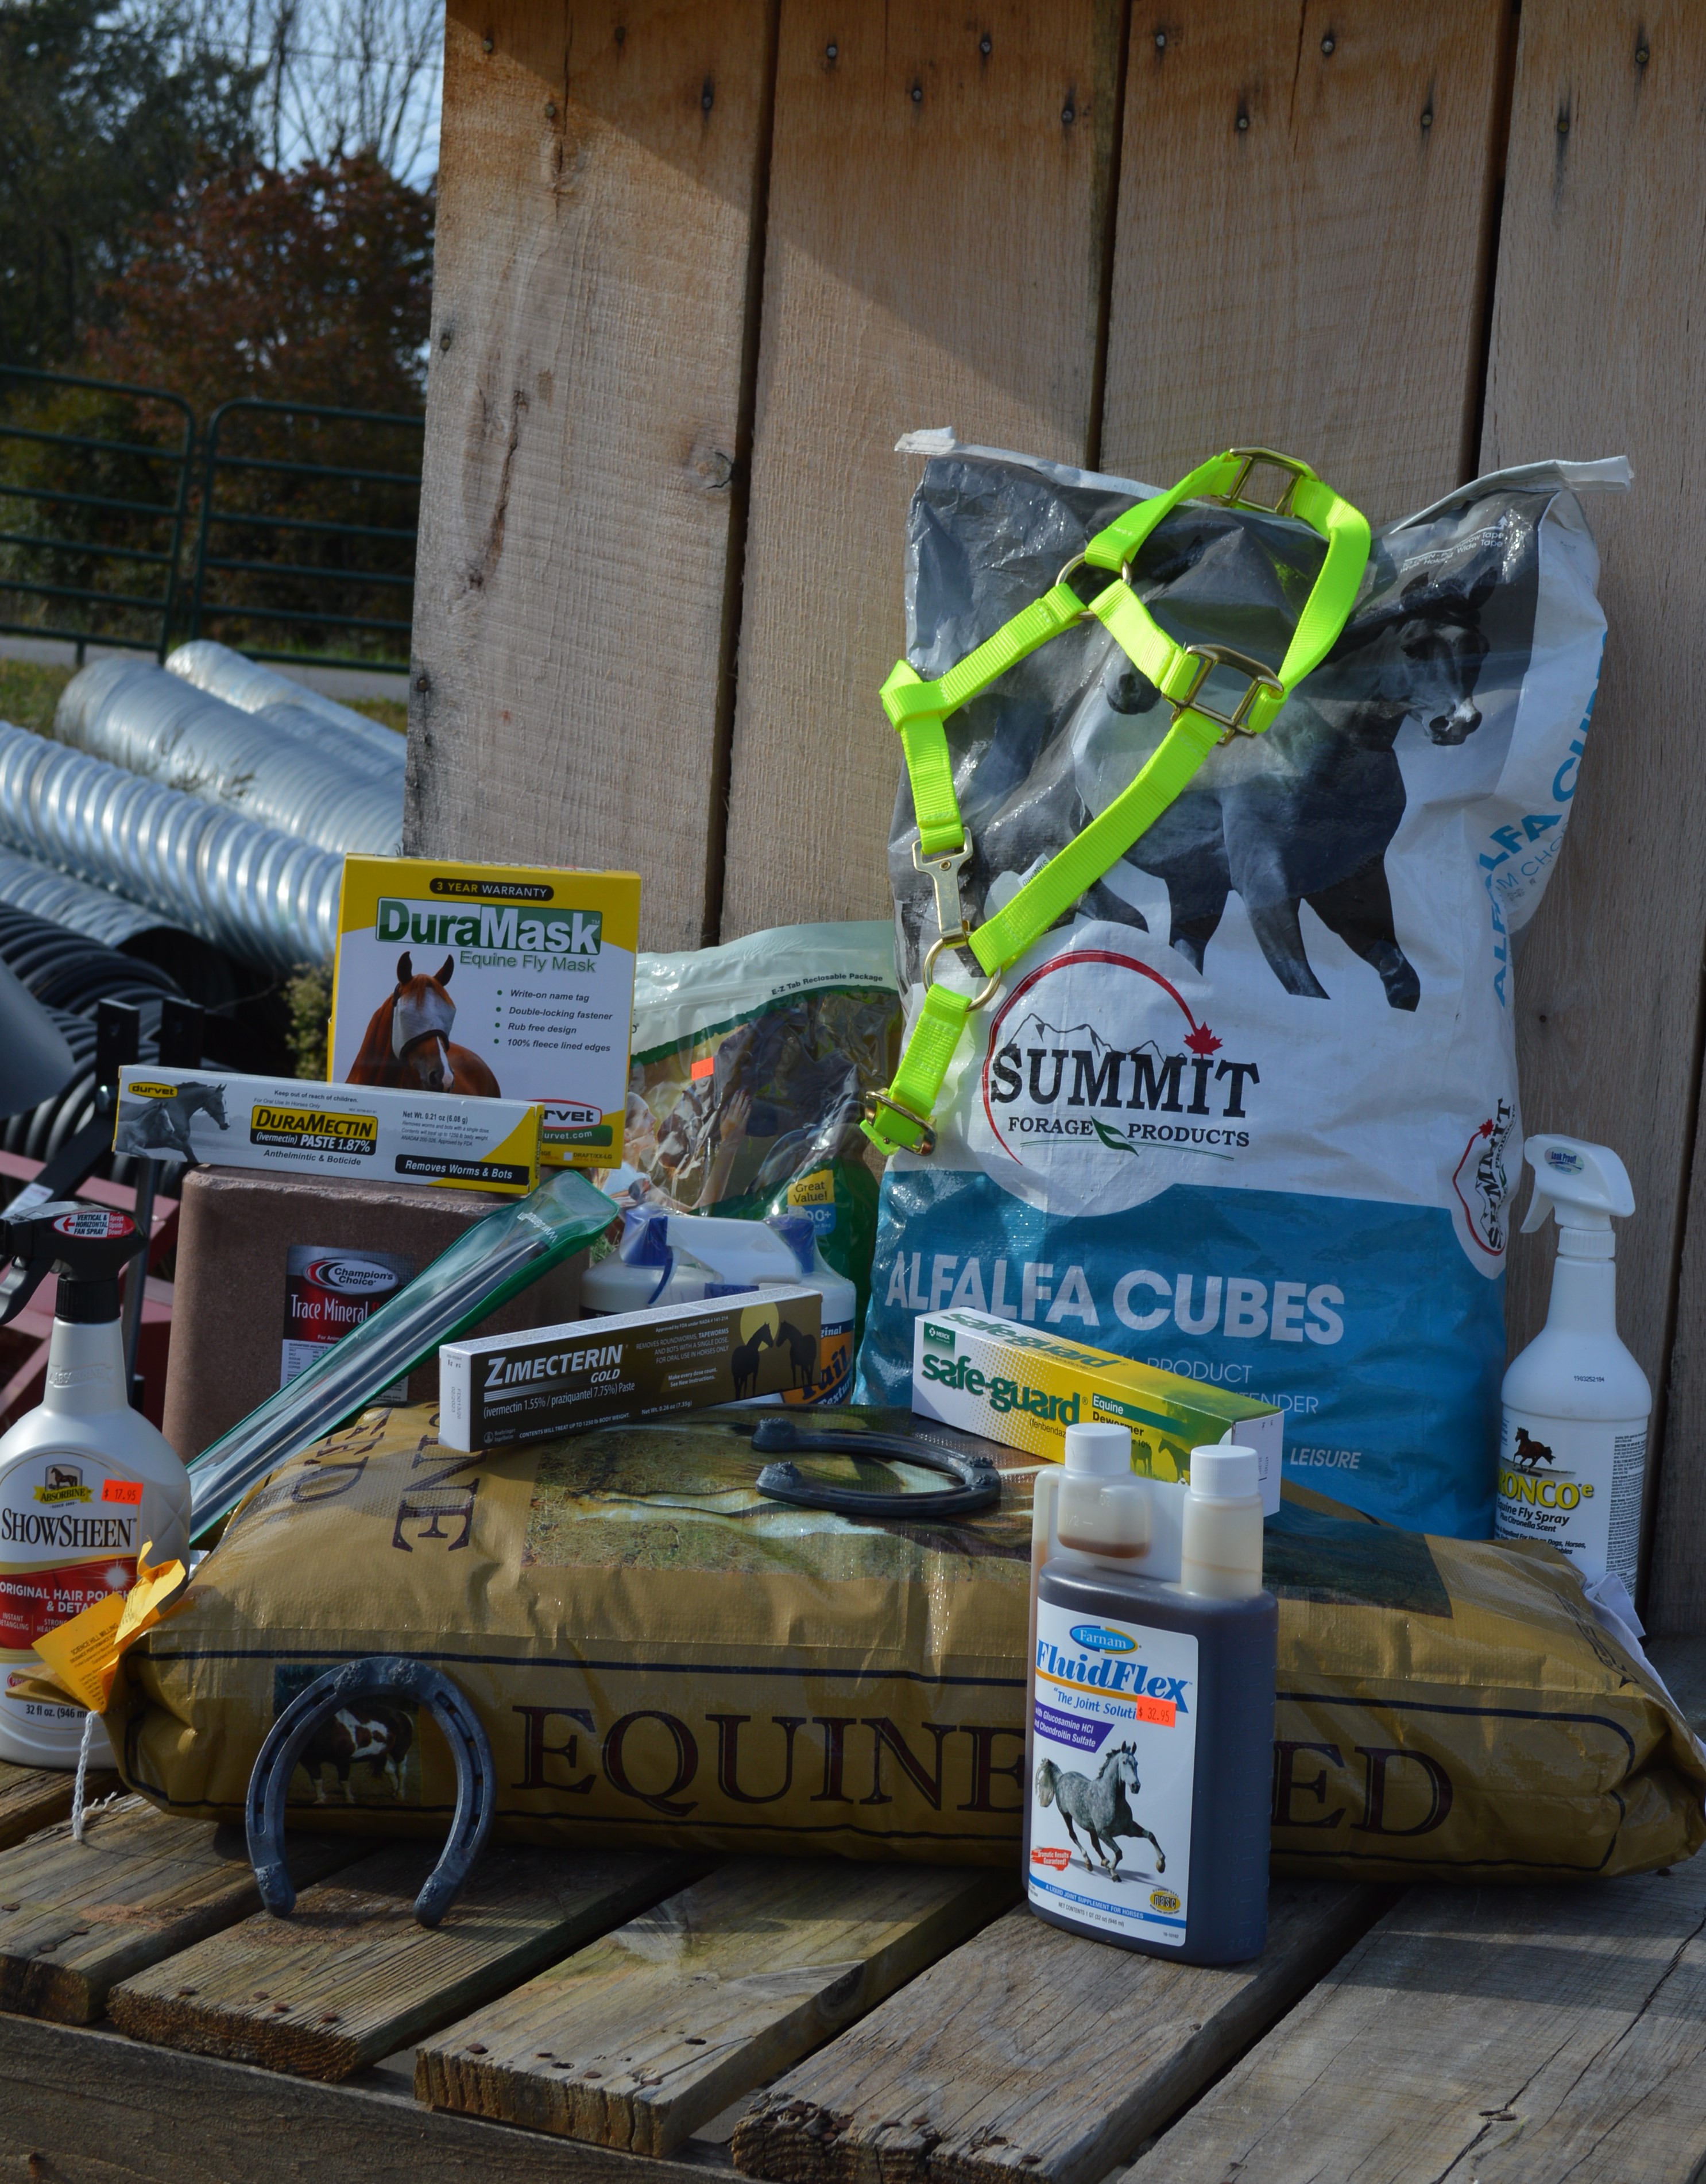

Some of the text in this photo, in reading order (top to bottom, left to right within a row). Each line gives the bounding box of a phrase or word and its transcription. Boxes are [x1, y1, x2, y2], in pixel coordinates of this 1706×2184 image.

[1457, 543, 1476, 553] Wide
[448, 883, 478, 893] YEAR
[482, 885, 547, 897] WARRANTY
[378, 900, 598, 954] DuraMask
[460, 950, 595, 973] Equine Fly Mask
[771, 973, 883, 995] E-Z Tab Reclosable Package
[510, 989, 589, 1002] Write-on name tag
[509, 1006, 613, 1020] Double-locking fastener
[508, 1023, 577, 1035] Rub free design
[508, 1039, 610, 1052] 100% fleece lined edges
[991, 1044, 1260, 1118] SUMMIT
[133, 1085, 174, 1095] durvet
[545, 1110, 593, 1122] rvet
[543, 1131, 592, 1139] urvet.com
[1008, 1117, 1249, 1147] FORAGE PRODUCTS
[257, 1132, 370, 1152] (ivermectin) PASTE 1.87%
[264, 1149, 316, 1161] Anthelmintic
[327, 1155, 361, 1165] Boticide
[405, 1160, 512, 1179] Removes Worms & Bots
[796, 1182, 825, 1192] Great
[794, 1191, 827, 1203] Value!
[335, 1268, 393, 1280] Champion's
[339, 1276, 374, 1285] Choice
[885, 1251, 1345, 1345] ALFALFA CUBES
[291, 1294, 320, 1319] Trace
[324, 1298, 368, 1323] Mineral
[636, 1328, 729, 1349] REMOVES TAPEWORMS
[936, 1331, 950, 1340] MERCK
[667, 1354, 680, 1362] ORAL
[697, 1348, 715, 1356] HORSES
[484, 1344, 623, 1387] ZIMECTERIN
[1148, 1358, 1252, 1383] PRODUCT
[591, 1369, 620, 1383] GOLD
[922, 1354, 1081, 1427] safe-guard
[483, 1383, 635, 1419] (ivermectin 1.55% praziquantel 7.75%) Paste
[1093, 1396, 1123, 1414] Equine
[520, 1429, 543, 1438] CONTENTS
[1030, 1418, 1066, 1436] (fenbendaz
[1290, 1447, 1361, 1469] LEISURE
[41, 1488, 86, 1501] ABSORBINE
[104, 1489, 136, 1501] $ 17.95
[1499, 1468, 1580, 1510] RONCO
[1508, 1516, 1556, 1532] Citronella Scent
[1518, 1508, 1533, 1521] Fly
[1535, 1511, 1569, 1527] Spray
[1548, 1539, 1564, 1547] Dogs,
[0, 1582, 83, 1601] ORIGINAL HAIR
[47, 1602, 55, 1612] &
[2, 1613, 24, 1622] INSTANT
[1080, 1629, 1126, 1649] Farnam
[1036, 1639, 1189, 1713] FluidFlex
[26, 1705, 35, 1714] 32
[37, 1706, 42, 1716] fl
[57, 1707, 75, 1718] (946
[1074, 1697, 1137, 1720] Joint Soluti
[1138, 1707, 1170, 1722] $ 32.95
[1043, 1709, 1080, 1730] Glucosamine
[1039, 1722, 1096, 1748] Chondroitin Sulfate
[511, 1705, 1028, 1817] EQUINE
[1050, 1885, 1063, 1895] LIQUID
[1064, 1890, 1077, 1902] JOINT
[1078, 1896, 1109, 1910] SUPPLEMENT
[1111, 1904, 1121, 1913] FOR
[1122, 1908, 1144, 1919] HORSES
[1066, 1904, 1084, 1915] CONTENTS
[1154, 1895, 1175, 1908] nasc
